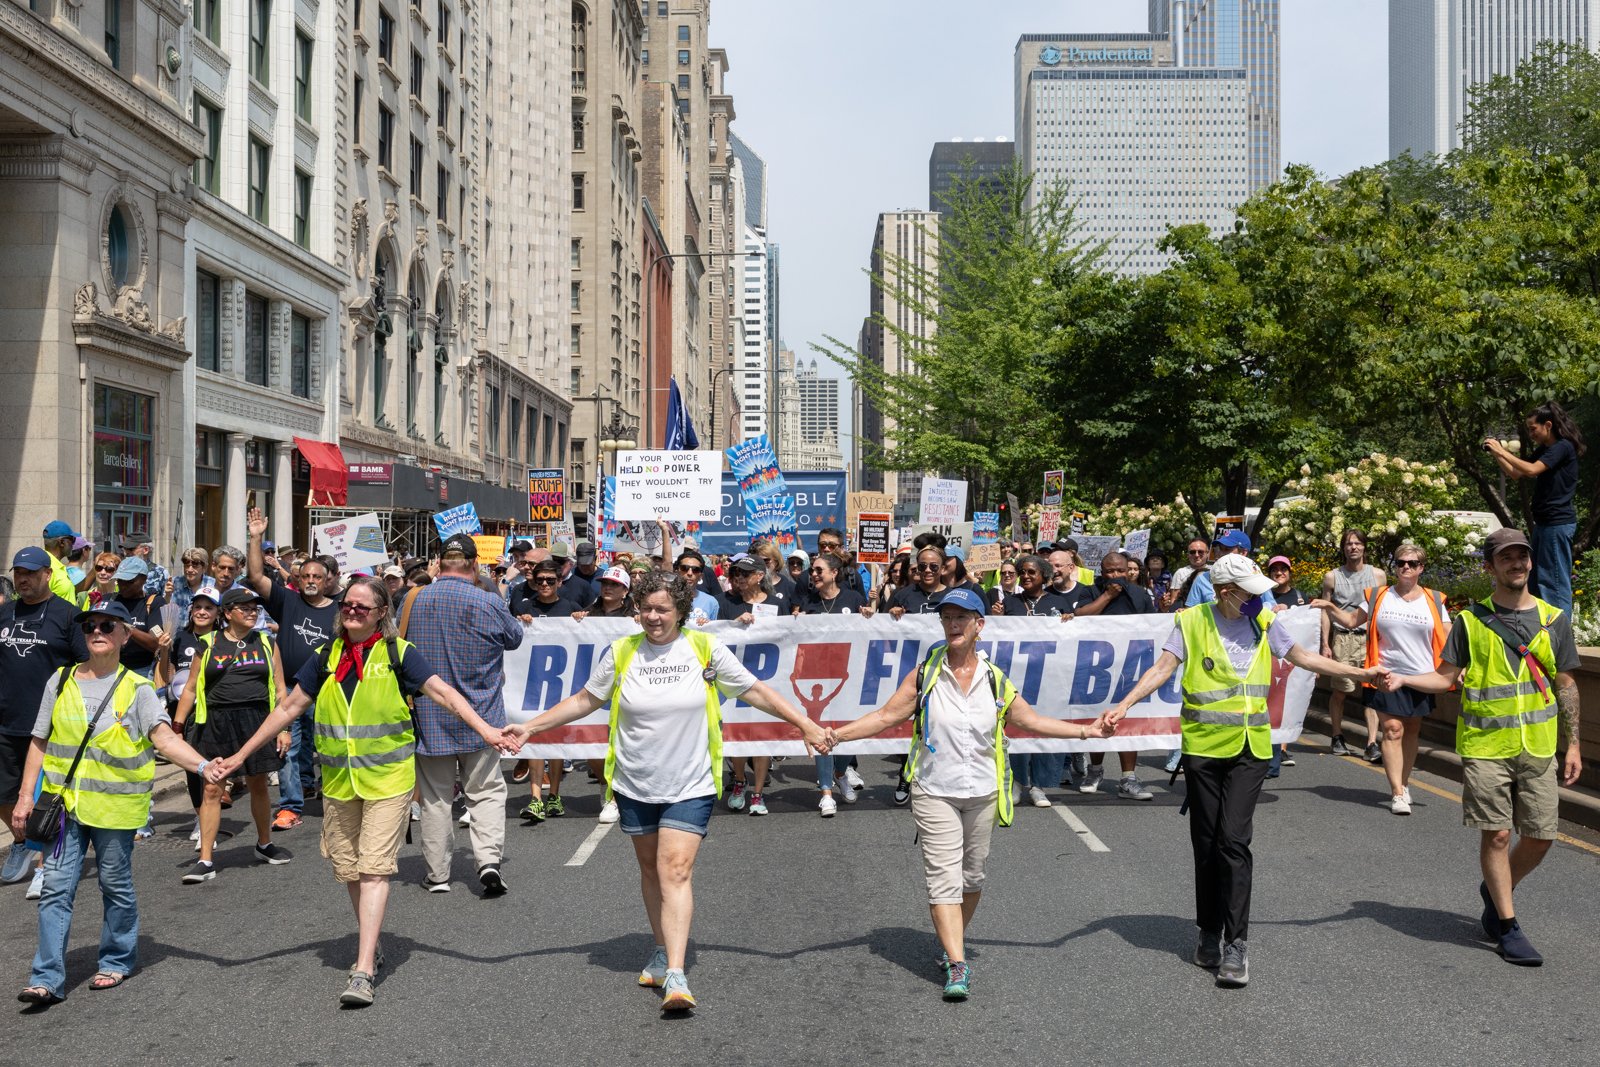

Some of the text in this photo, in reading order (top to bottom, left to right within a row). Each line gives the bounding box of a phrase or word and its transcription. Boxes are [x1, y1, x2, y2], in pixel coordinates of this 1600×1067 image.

[1068, 47, 1153, 61] Prudential
[736, 442, 762, 457] RISE UP
[120, 453, 141, 470] Gallery
[734, 448, 770, 466] FIGHT BACK
[645, 465, 660, 473] NO
[664, 464, 700, 472] POWER
[531, 479, 562, 492] TRUMP
[645, 478, 688, 486] WOULDN'T
[655, 491, 691, 499] SILENCE
[929, 488, 958, 496] INJUSTICE
[530, 492, 563, 506] MUST GO
[853, 496, 869, 510] NO
[756, 503, 772, 511] RISE
[924, 503, 960, 516] RESISTANCE
[443, 512, 458, 522] RISE
[531, 505, 563, 520] NOW!
[751, 511, 770, 519] FIGHT
[1041, 512, 1060, 521] TRUMP
[458, 514, 475, 522] BACK
[932, 525, 952, 536] SIN
[1042, 531, 1055, 540] FOR
[1382, 611, 1427, 620] INDIVISIBLE
[639, 665, 690, 676] INFORMED
[649, 676, 681, 685] VOTER
